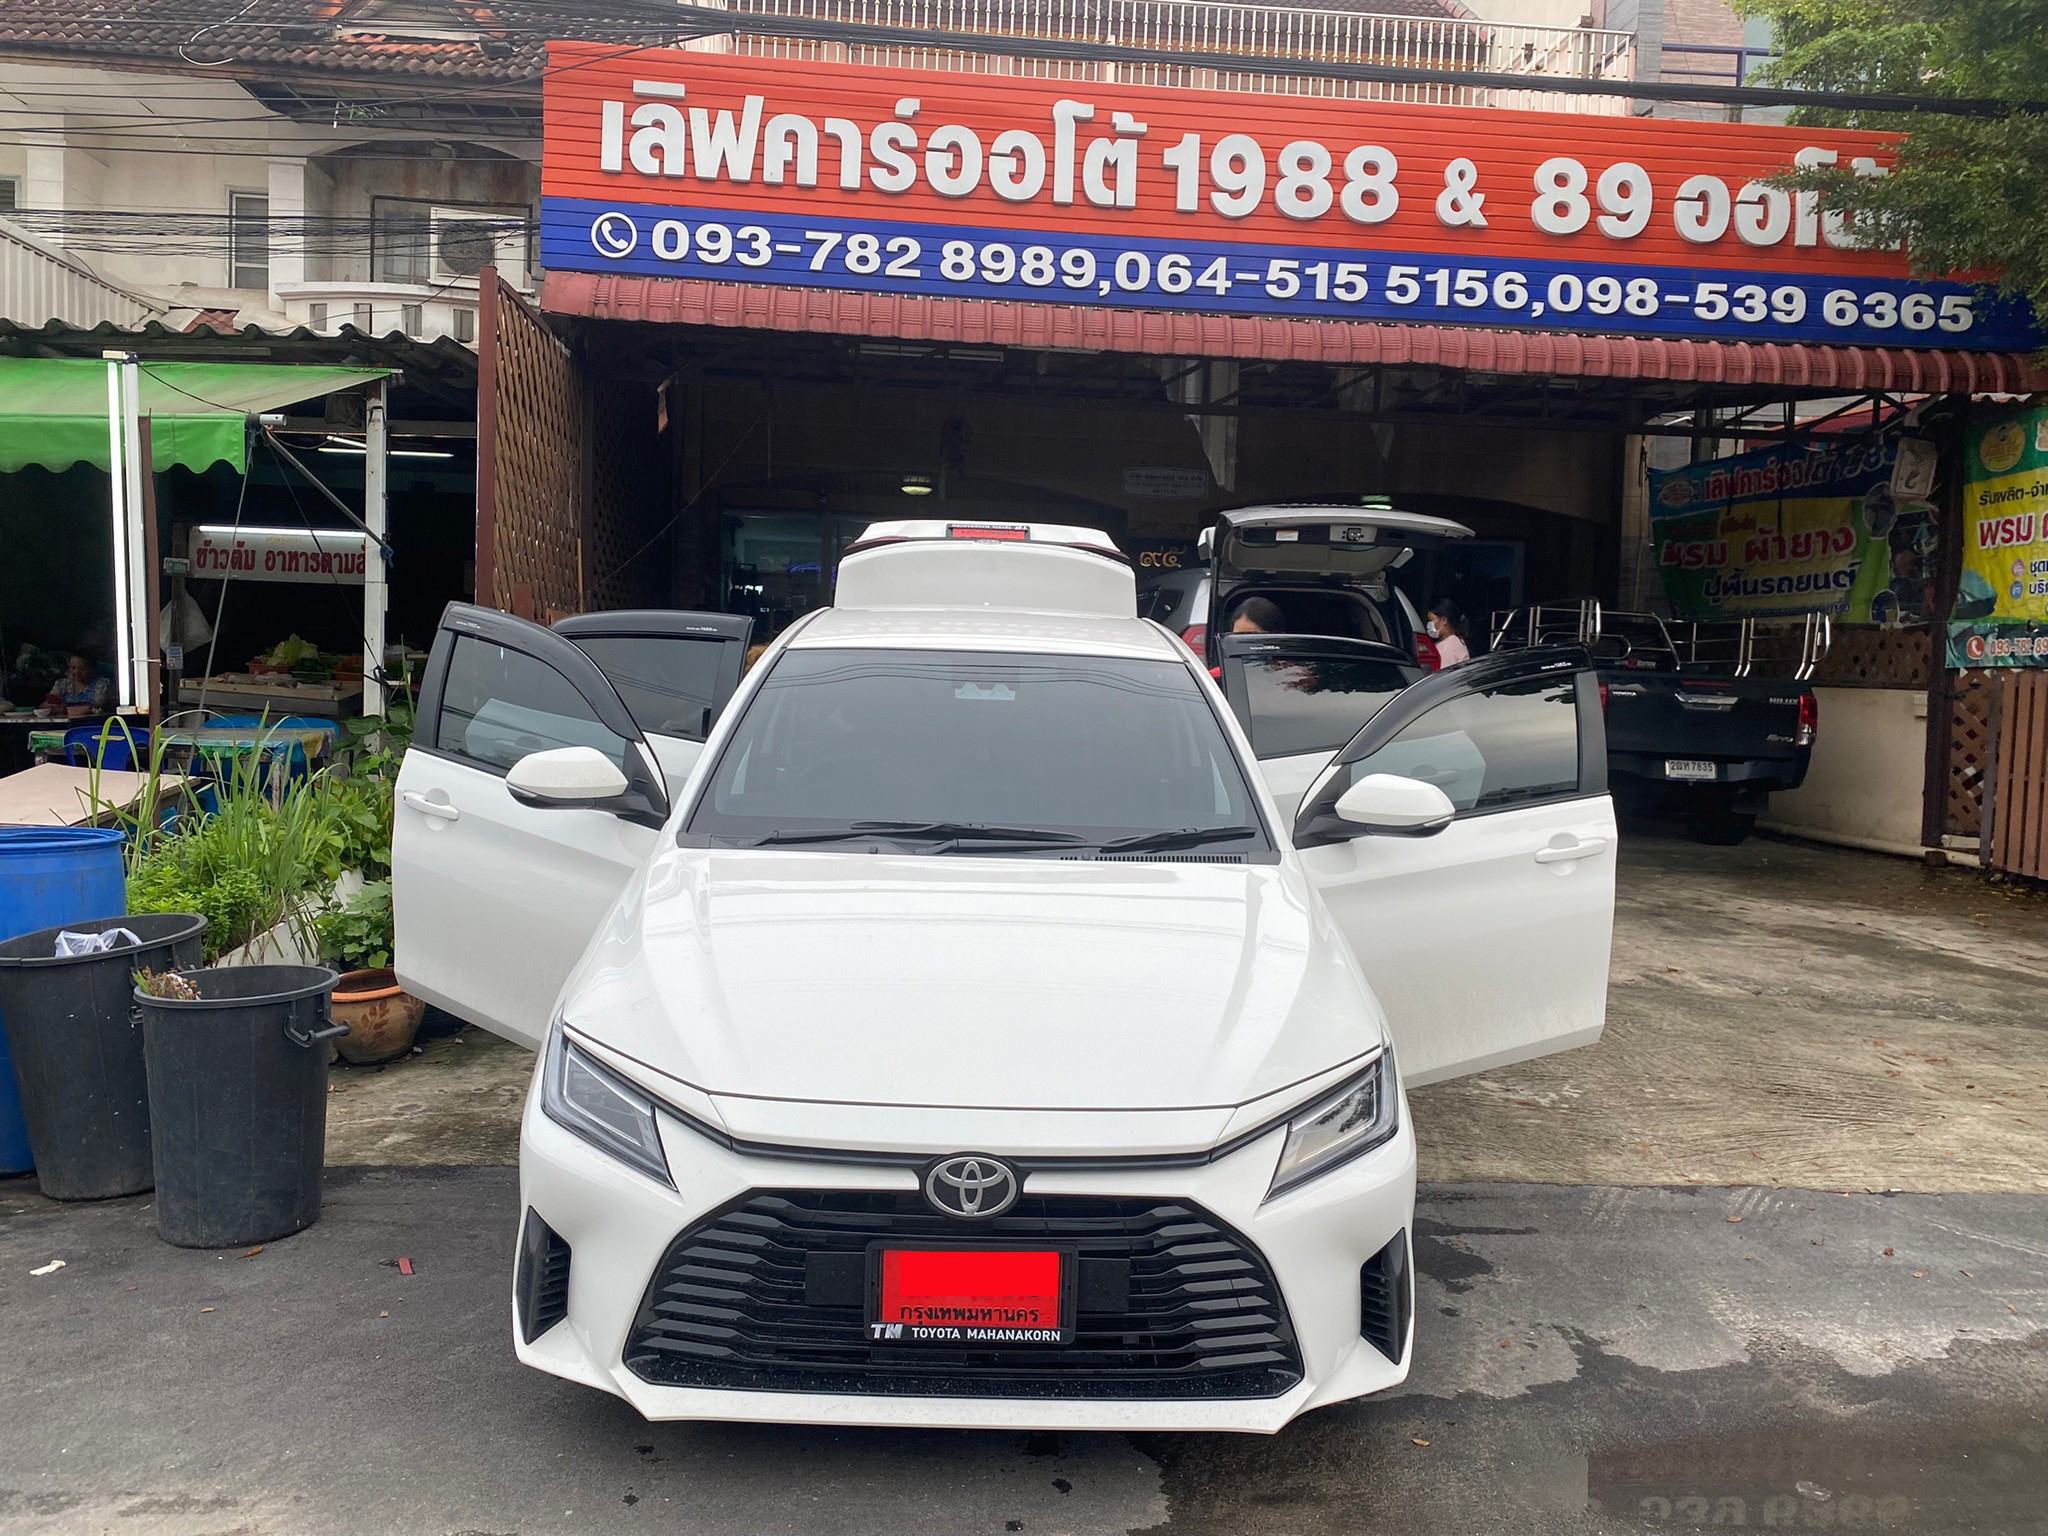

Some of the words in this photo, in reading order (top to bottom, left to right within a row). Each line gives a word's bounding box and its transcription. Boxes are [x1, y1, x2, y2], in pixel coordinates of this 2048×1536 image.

[600, 79, 1149, 210] เลิฟคาร์ออโต้
[1163, 132, 1400, 225] 1988
[1435, 156, 1489, 229] &
[1531, 156, 1653, 241] 89
[650, 218, 922, 280] 093-782
[939, 240, 1369, 303] 8989,064-515
[1384, 264, 1807, 328] 5156,098-539
[1821, 289, 1976, 334] 6365
[1744, 527, 1856, 564] ผ้ายาง
[1979, 513, 2034, 547] พรม
[899, 1302, 1040, 1325] กรุงเทพมหานคร
[911, 1326, 961, 1340] TOYOTA
[966, 1327, 1061, 1342] MAHANAKORN
